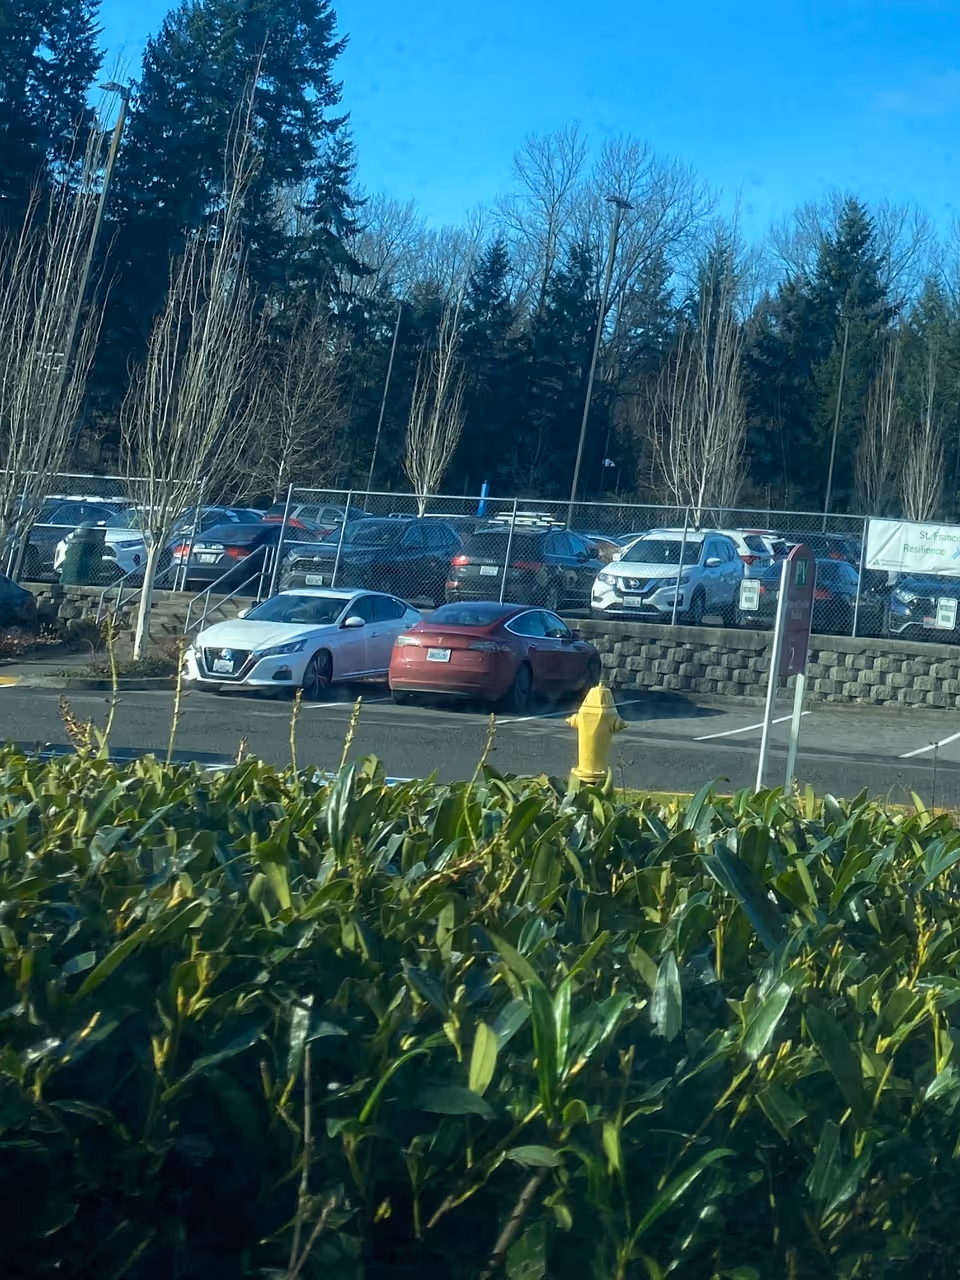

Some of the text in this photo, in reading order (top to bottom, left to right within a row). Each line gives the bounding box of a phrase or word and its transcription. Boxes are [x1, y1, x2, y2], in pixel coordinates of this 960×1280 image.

[919, 531, 931, 540] St.
[903, 544, 945, 555] Resilience
[794, 560, 810, 584] PV
[787, 647, 795, 670] 2
